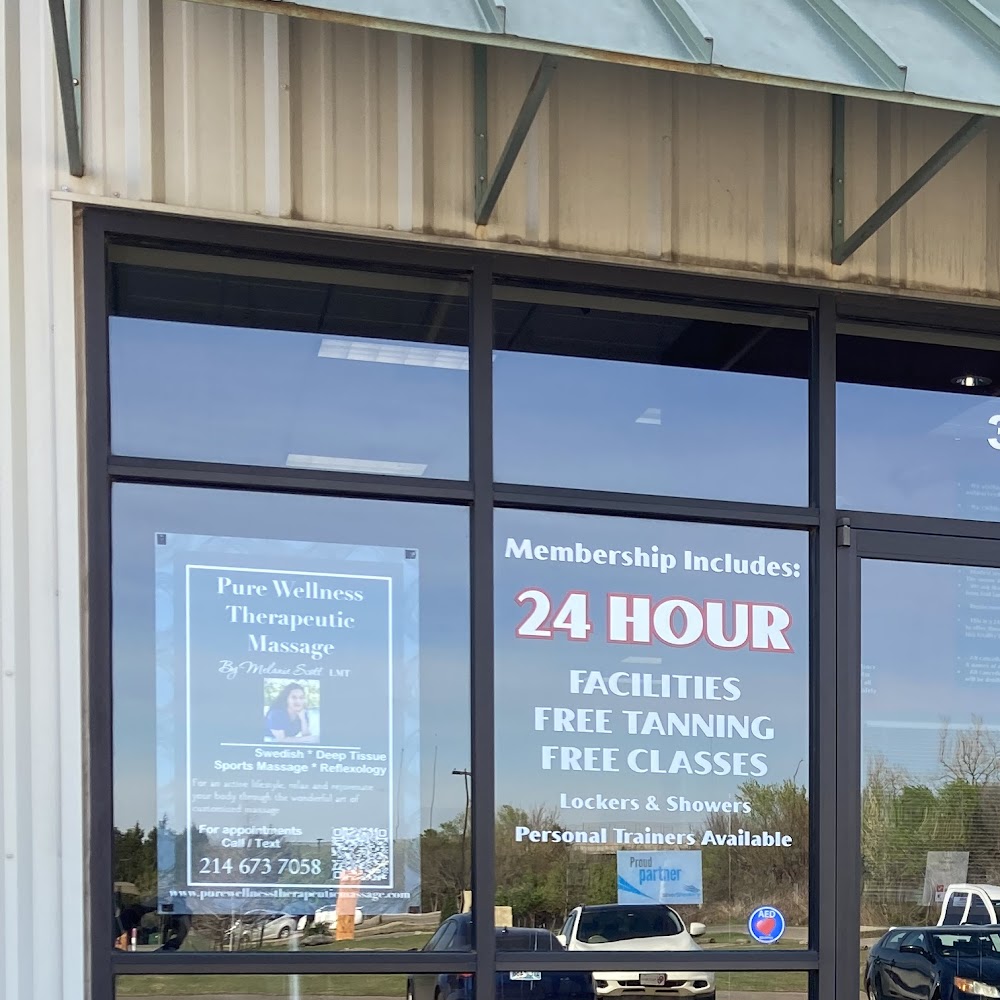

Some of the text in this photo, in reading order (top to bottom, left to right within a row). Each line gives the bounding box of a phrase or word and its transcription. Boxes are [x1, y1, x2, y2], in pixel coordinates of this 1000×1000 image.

[504, 537, 801, 578] Membership Includes:
[217, 576, 364, 602] Pure Wellness
[225, 605, 355, 632] Therapeutic
[514, 587, 795, 653] 24 HOUR
[248, 634, 335, 661] Massage
[218, 659, 239, 681] By
[329, 668, 351, 678] LMT
[569, 669, 742, 702] FACILITIES
[534, 706, 775, 741] FREE TANNING
[255, 748, 387, 763] Swedish Deep Tissue
[541, 745, 769, 778] FREE CLASSES
[214, 760, 387, 777] Sports Massage Reflexology
[560, 793, 752, 814] Lockers & Showers
[199, 824, 303, 837] For appointments
[514, 826, 793, 848] Personal Trainers Available
[222, 837, 247, 849] Call
[254, 838, 281, 849] Text
[199, 857, 322, 876] 214 673 7058
[629, 856, 653, 868] Proud
[638, 866, 682, 885] partner
[757, 909, 777, 919] AED
